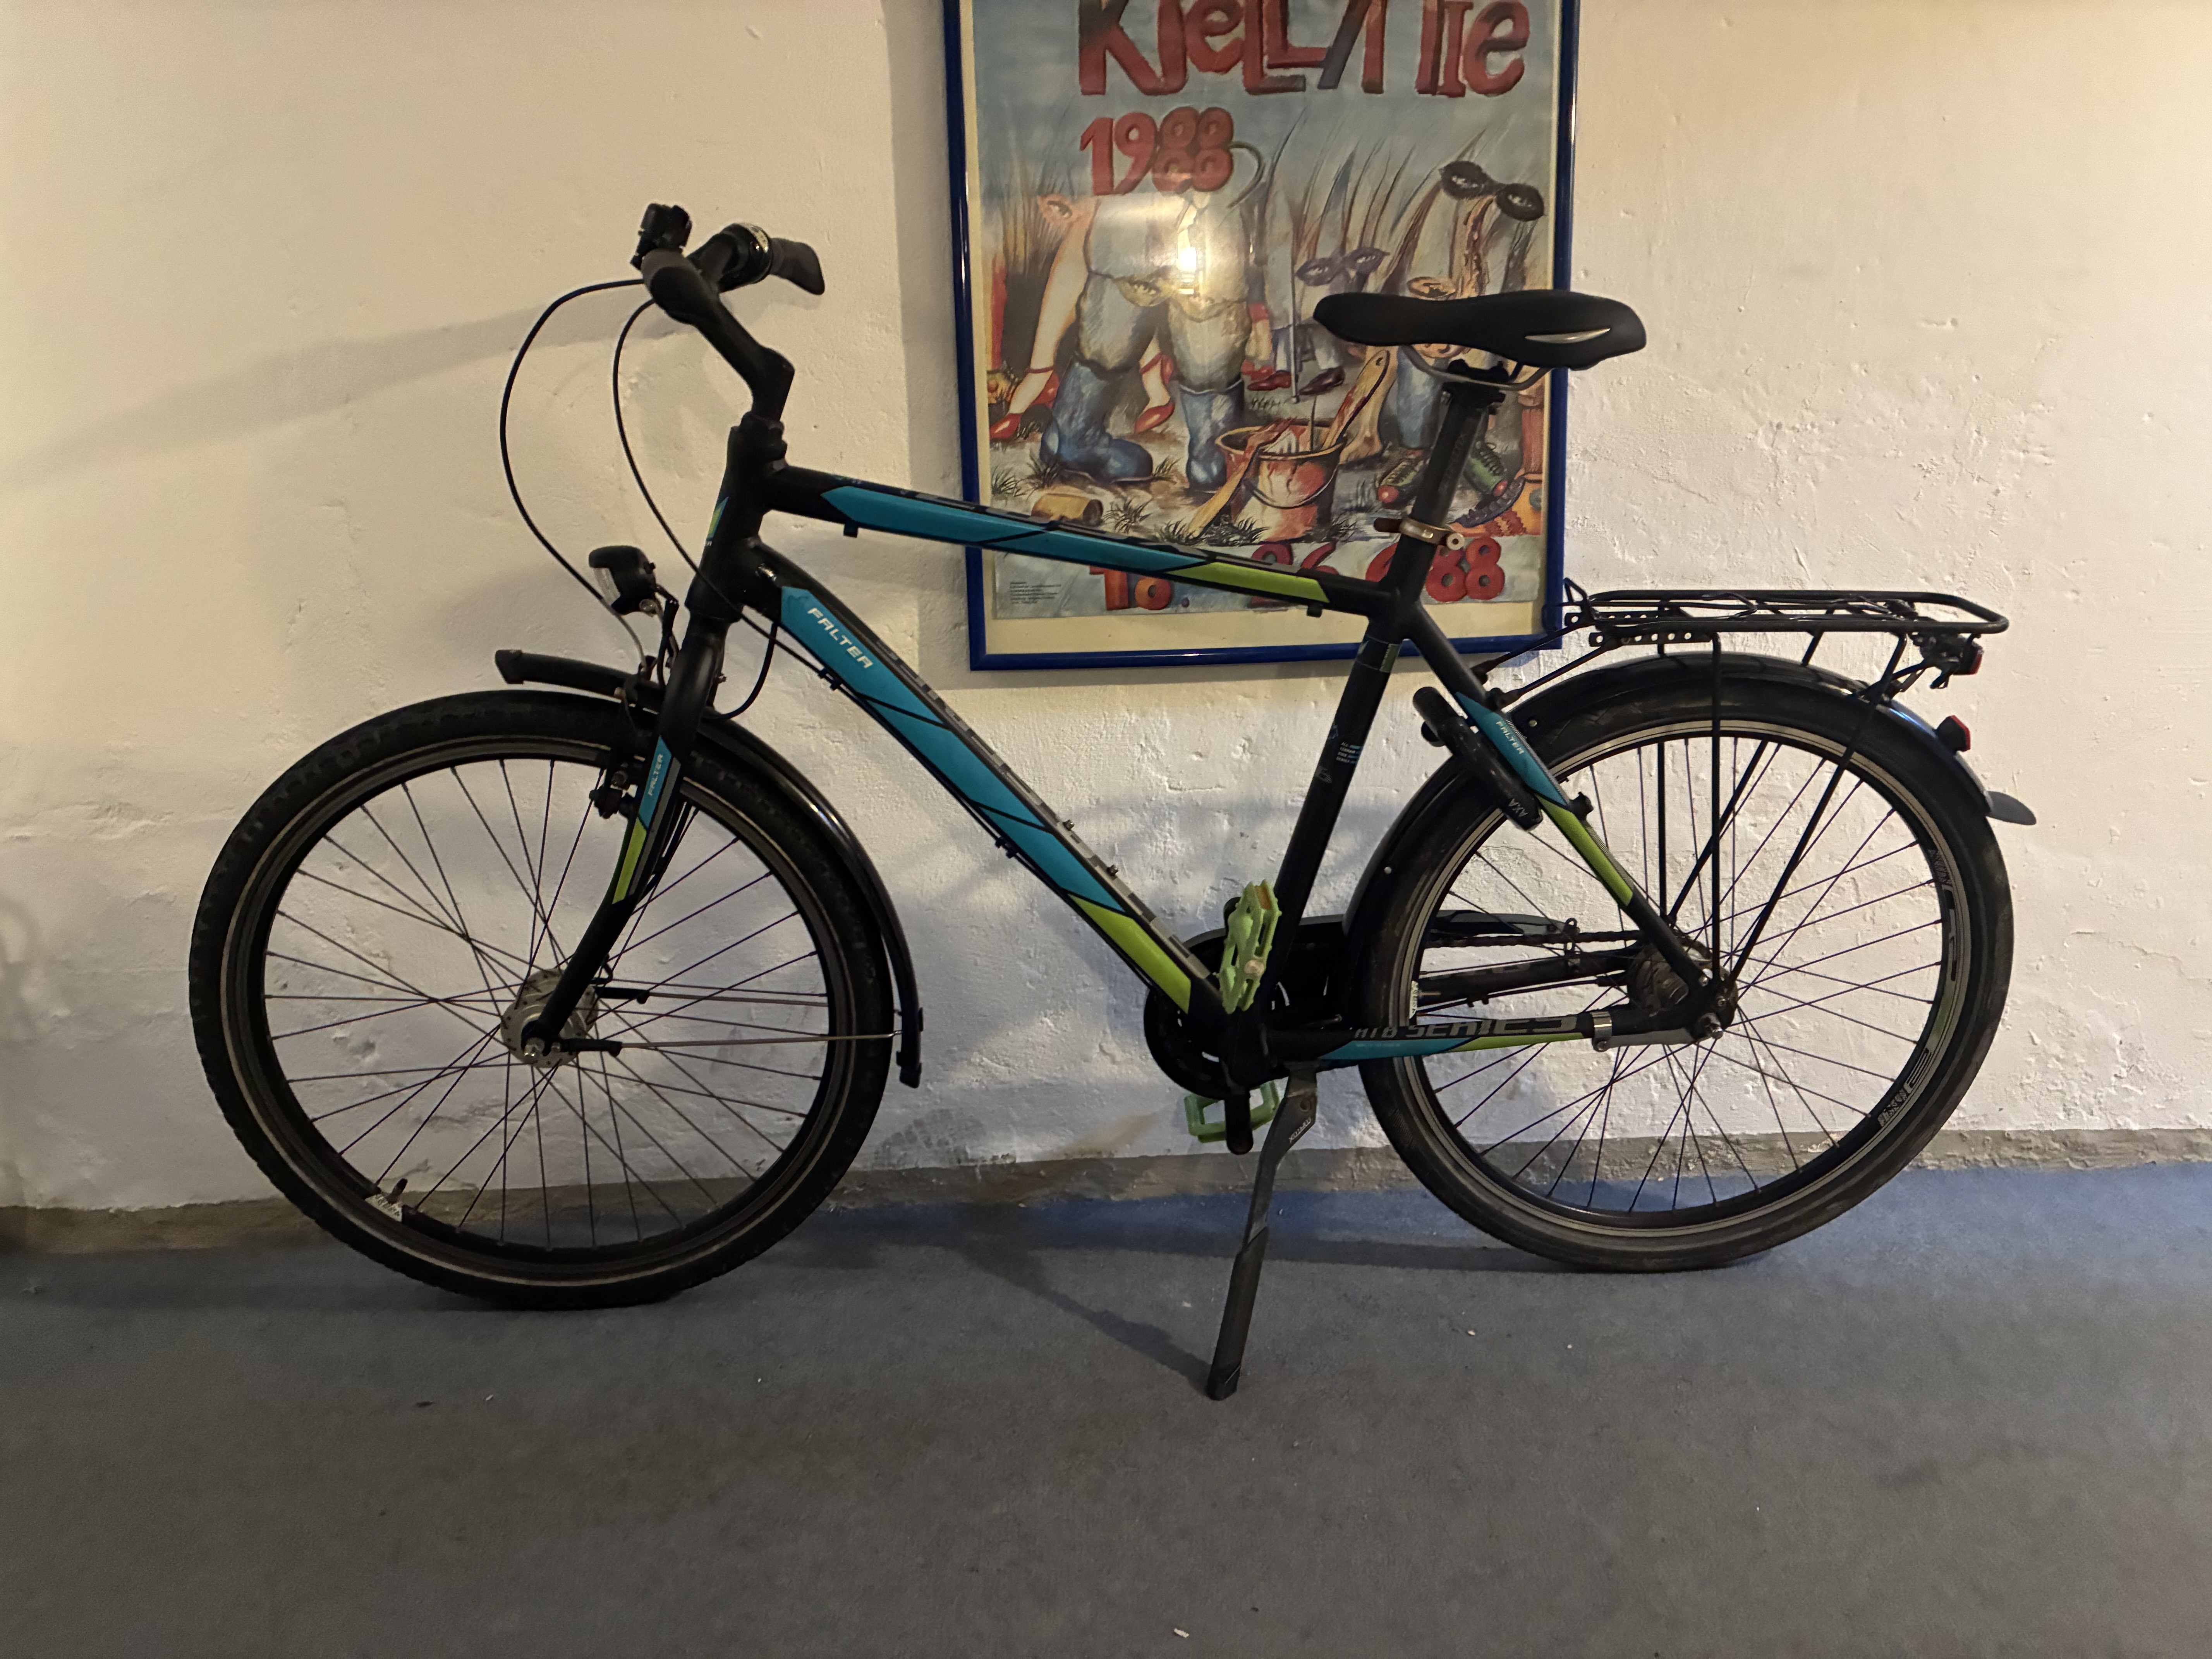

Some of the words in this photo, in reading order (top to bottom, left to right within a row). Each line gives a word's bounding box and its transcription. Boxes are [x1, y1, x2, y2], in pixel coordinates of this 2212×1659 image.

[1080, 106, 1234, 196] 1988
[807, 607, 874, 669] FALTER
[1495, 720, 1525, 755] FALTER
[648, 753, 663, 797] FALTER
[1508, 798, 1528, 817] AXA
